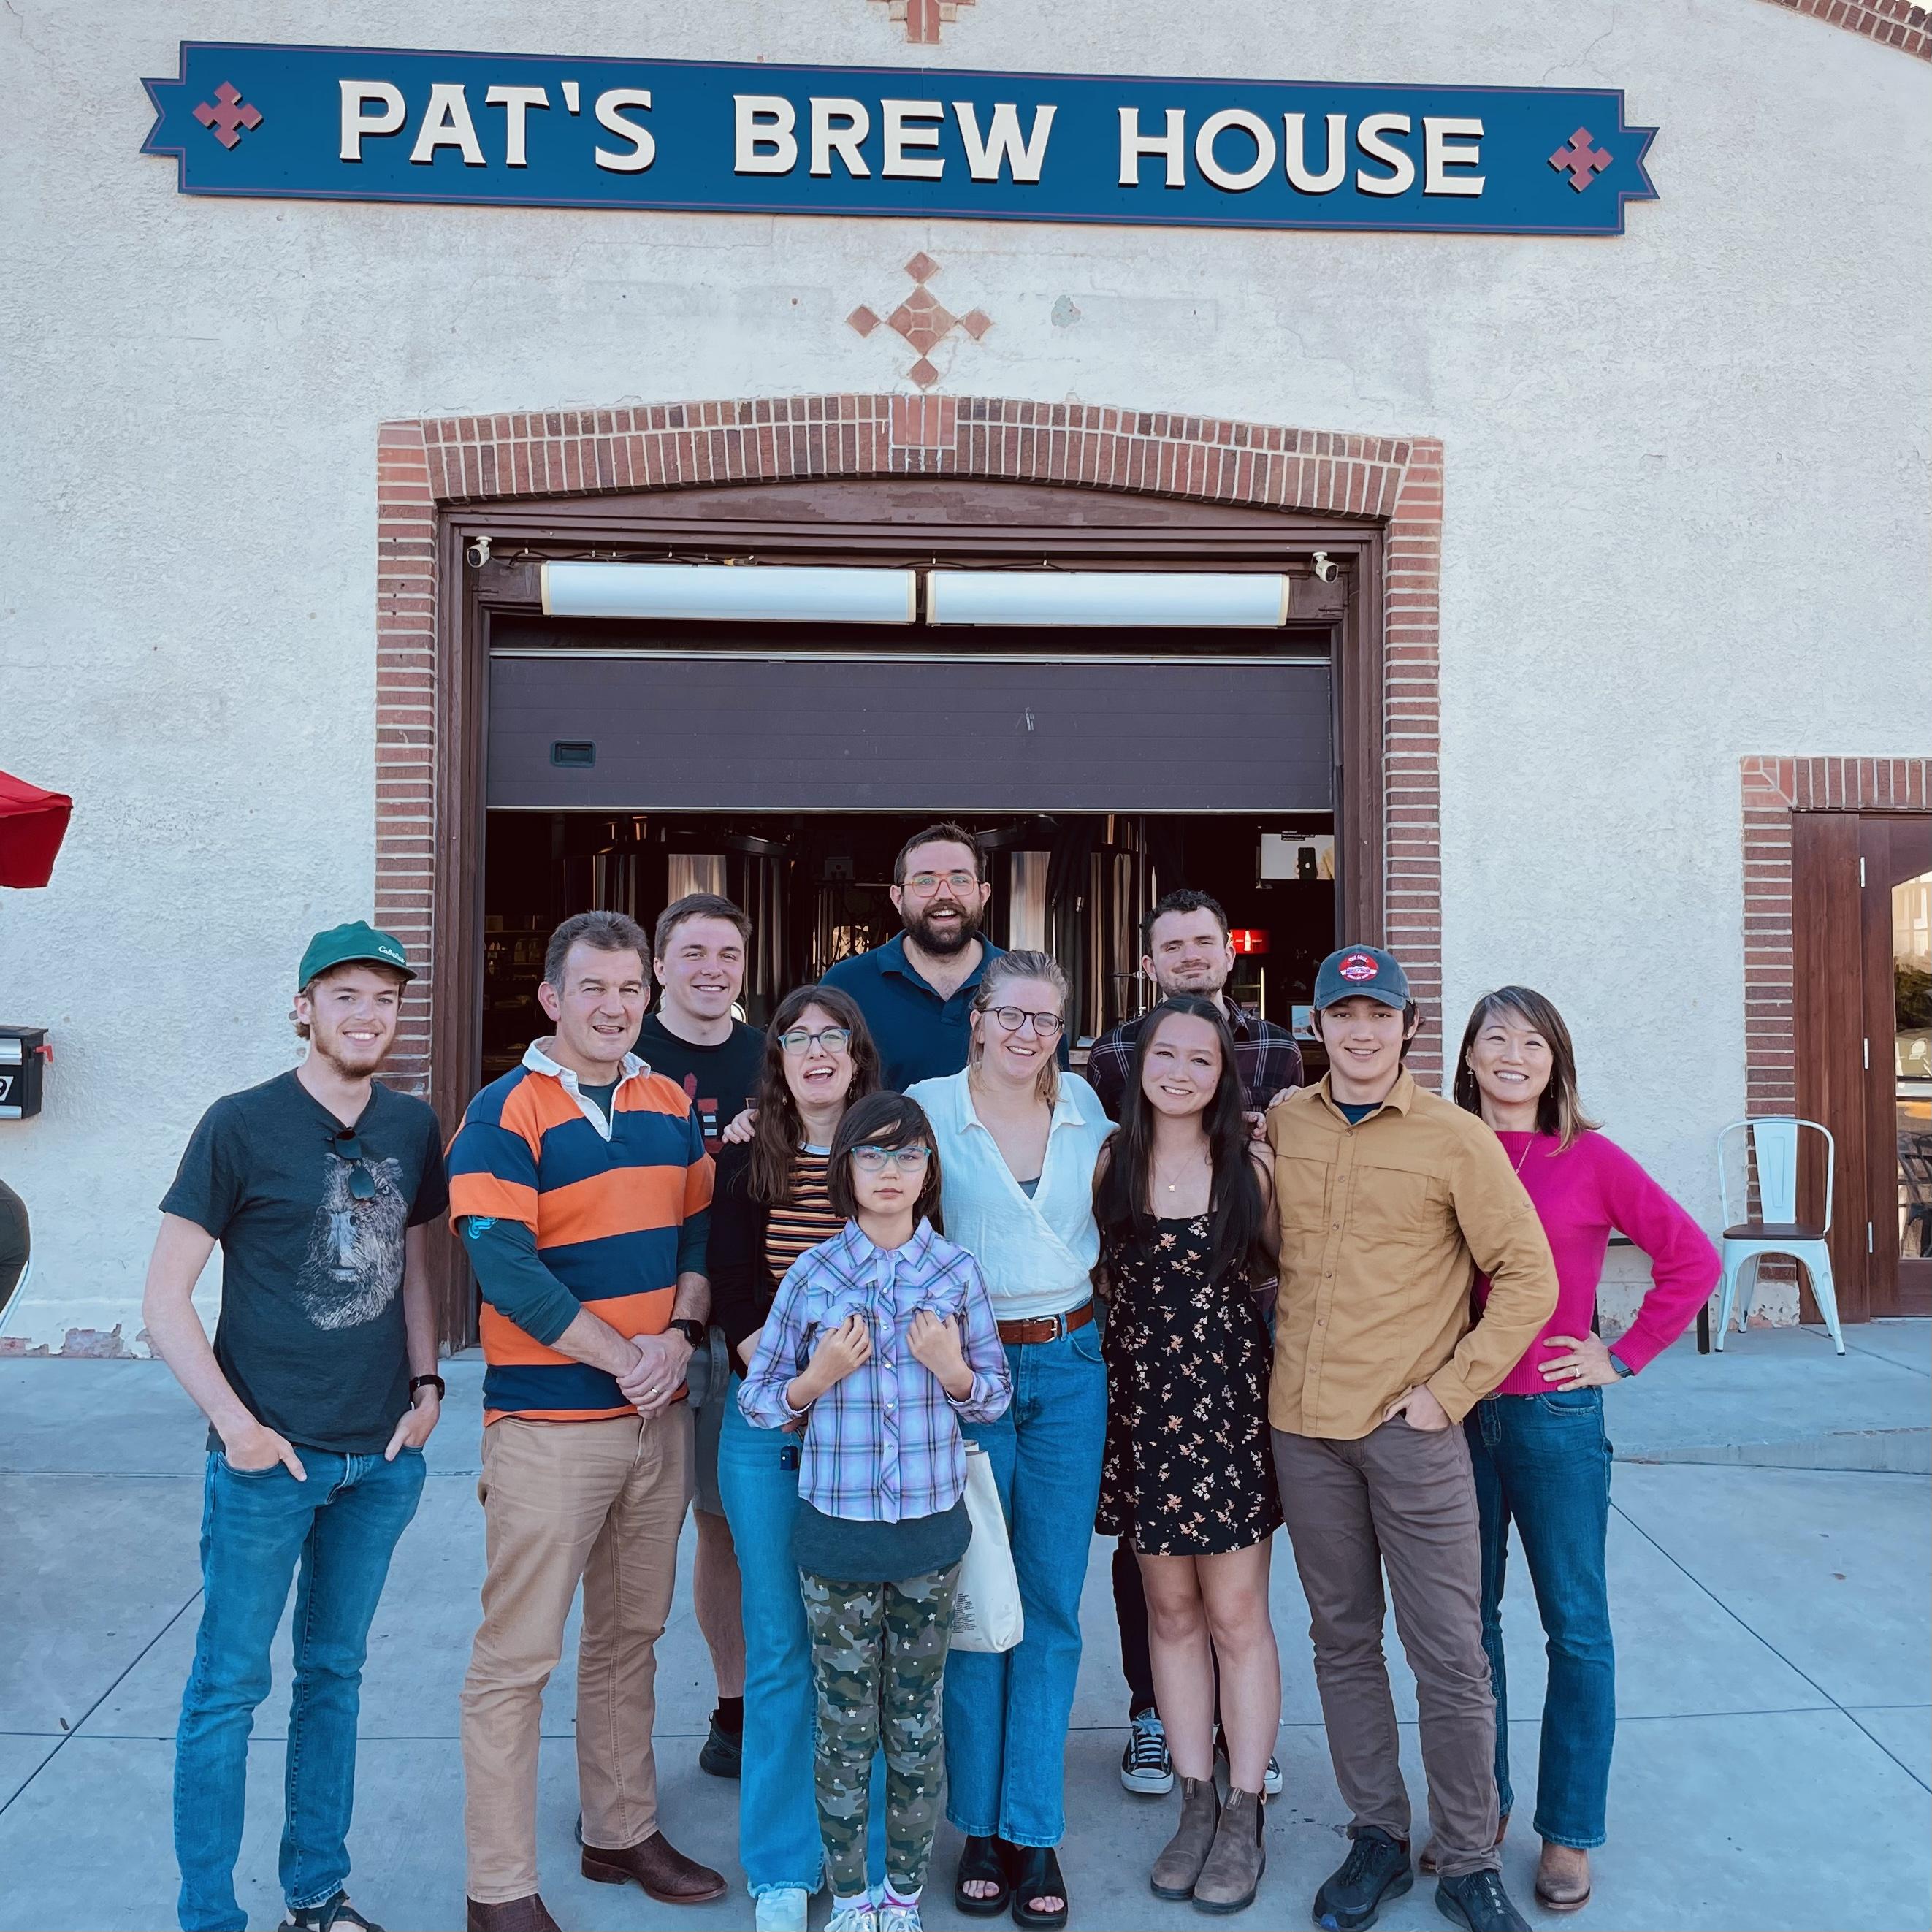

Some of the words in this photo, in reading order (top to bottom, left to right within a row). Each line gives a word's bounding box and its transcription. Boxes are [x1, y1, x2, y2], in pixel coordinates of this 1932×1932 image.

[337, 80, 656, 172] PAT'S
[733, 96, 1058, 182] BREW
[1118, 107, 1486, 196] HOUSE
